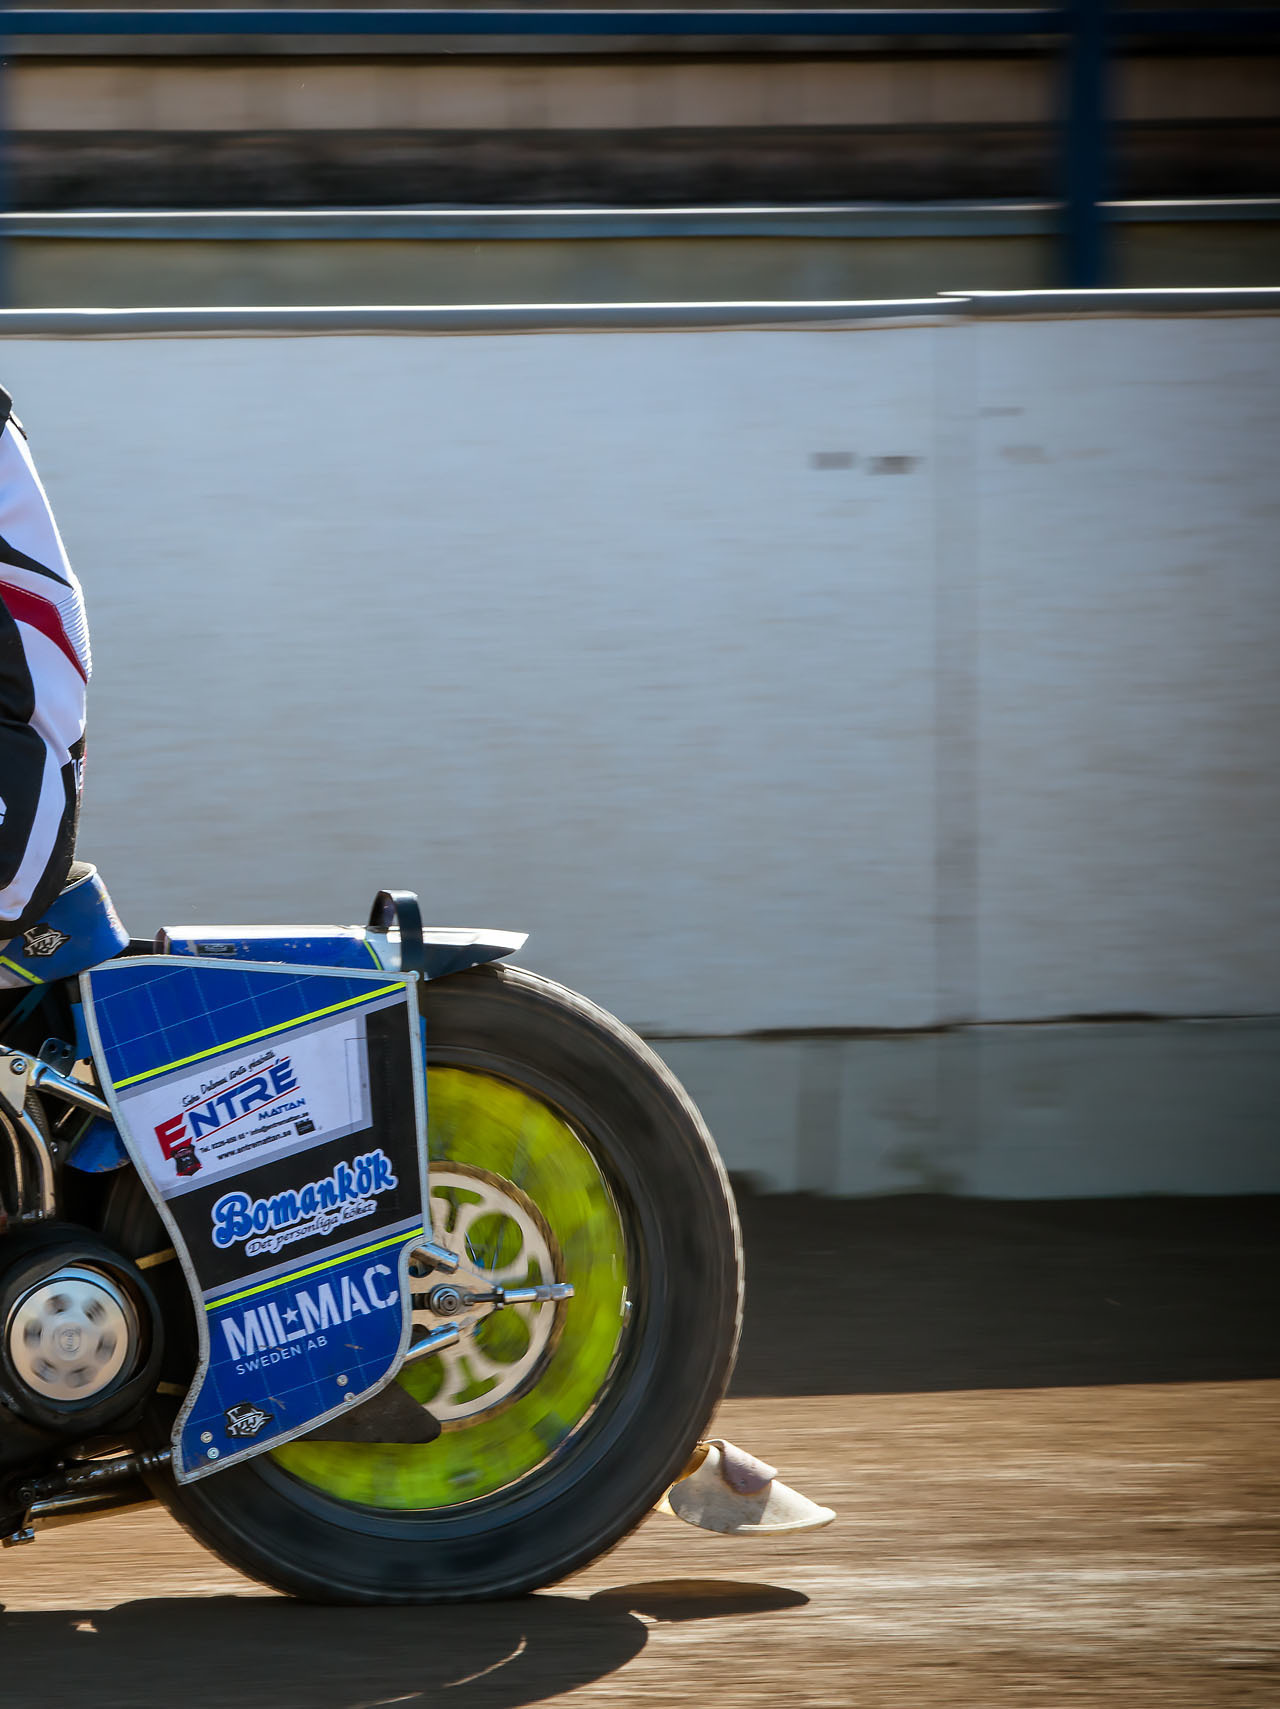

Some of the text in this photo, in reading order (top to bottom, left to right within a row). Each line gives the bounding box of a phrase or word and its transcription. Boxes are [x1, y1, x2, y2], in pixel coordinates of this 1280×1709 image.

[258, 1097, 306, 1122] MATTAN
[214, 1150, 396, 1246] Bomankök
[248, 1237, 273, 1254] Det
[273, 1215, 339, 1251] personliga
[235, 1335, 328, 1376] SWEDEN AB
